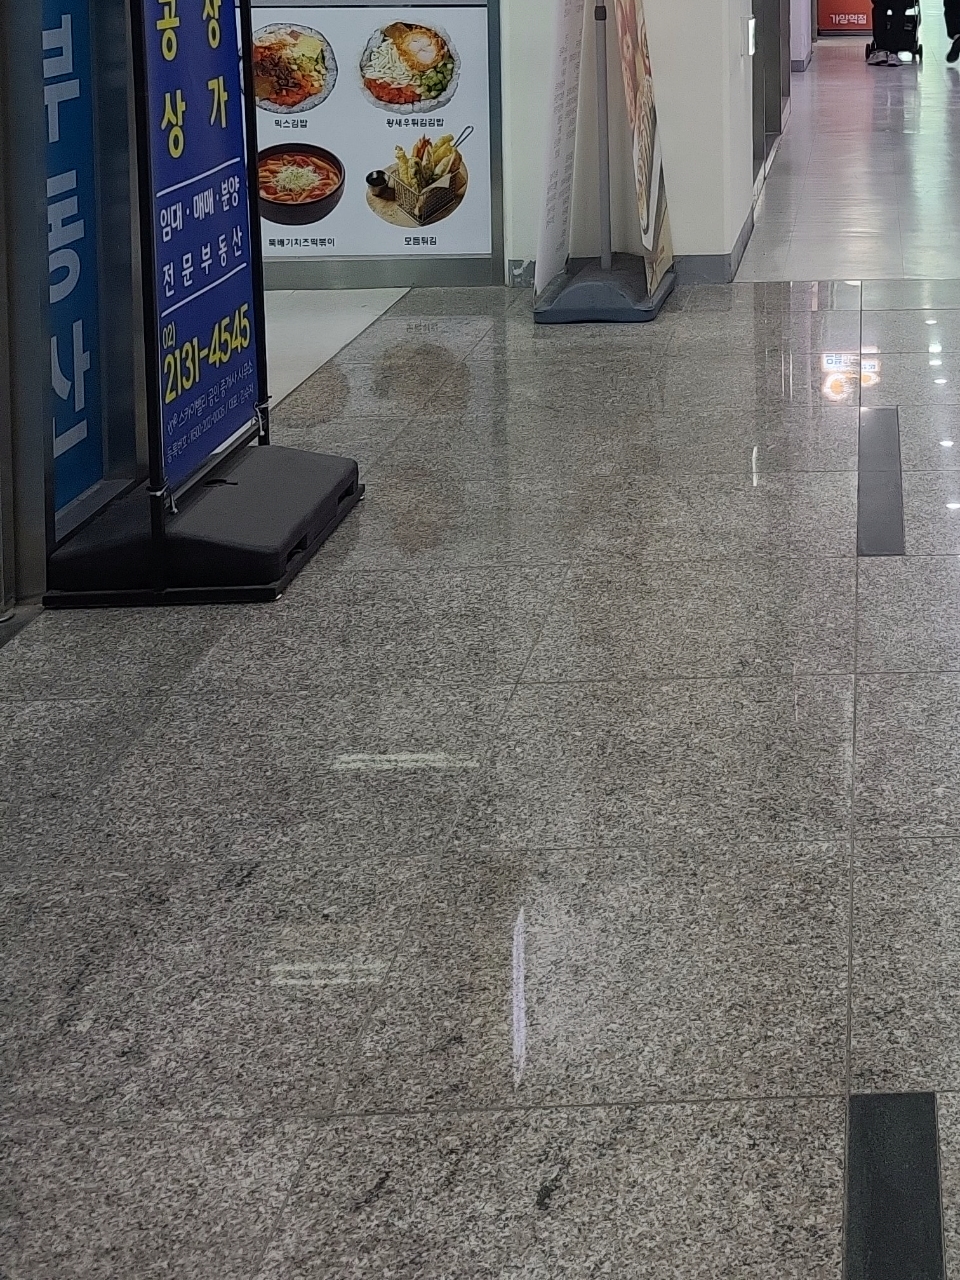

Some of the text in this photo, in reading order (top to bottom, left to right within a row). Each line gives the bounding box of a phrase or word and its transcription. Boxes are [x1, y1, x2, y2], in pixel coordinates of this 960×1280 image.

[829, 14, 867, 24] 가양역점
[274, 119, 308, 129] 믹스김밥
[386, 117, 445, 128] 왕새우튀김김밥
[160, 174, 240, 243] 임대 매매 분양
[268, 237, 335, 248] 뚝배기치즈떡볶이
[162, 303, 251, 405] 2131-4545
